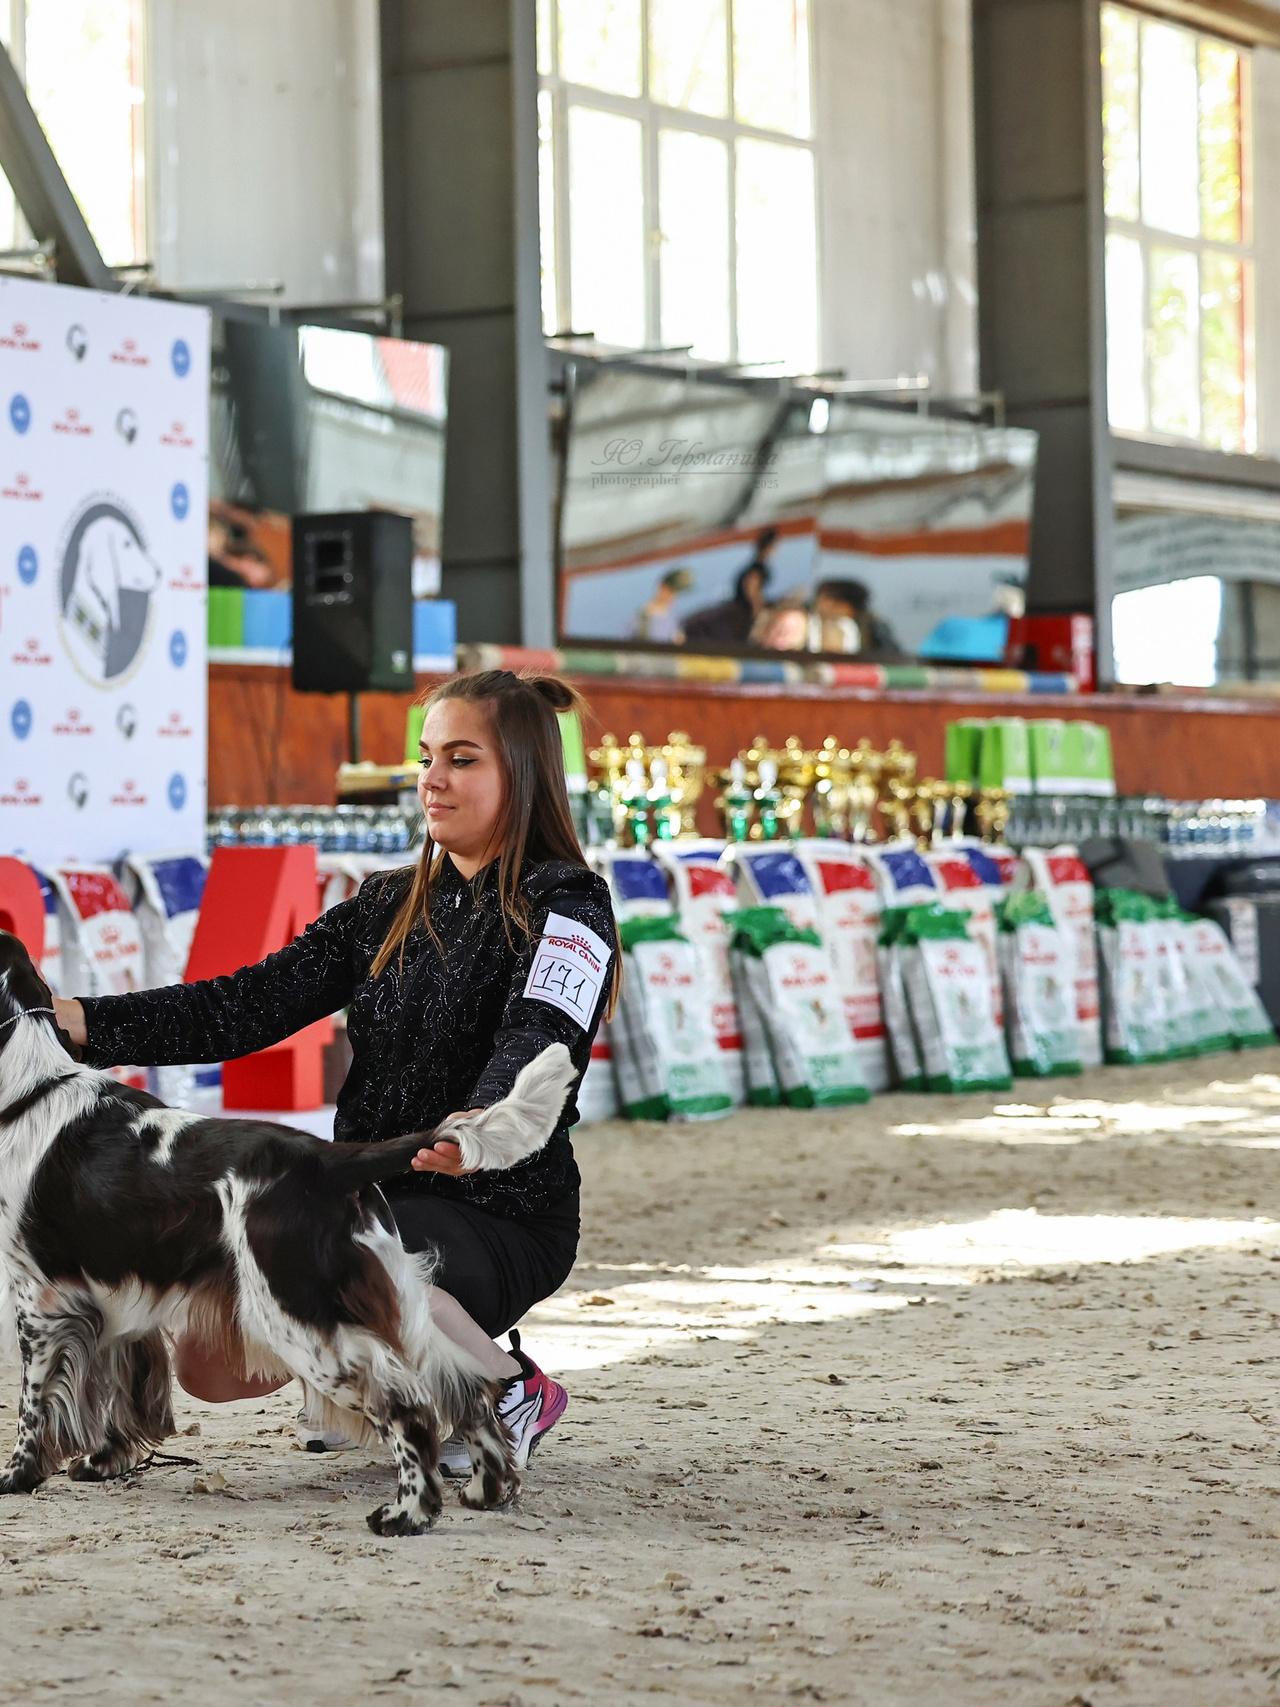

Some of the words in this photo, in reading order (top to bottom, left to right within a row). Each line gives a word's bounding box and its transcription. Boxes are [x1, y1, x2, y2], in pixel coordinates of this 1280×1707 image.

[548, 938, 578, 954] ROYAL
[578, 949, 601, 973] CANIN
[532, 960, 586, 1013] 171
